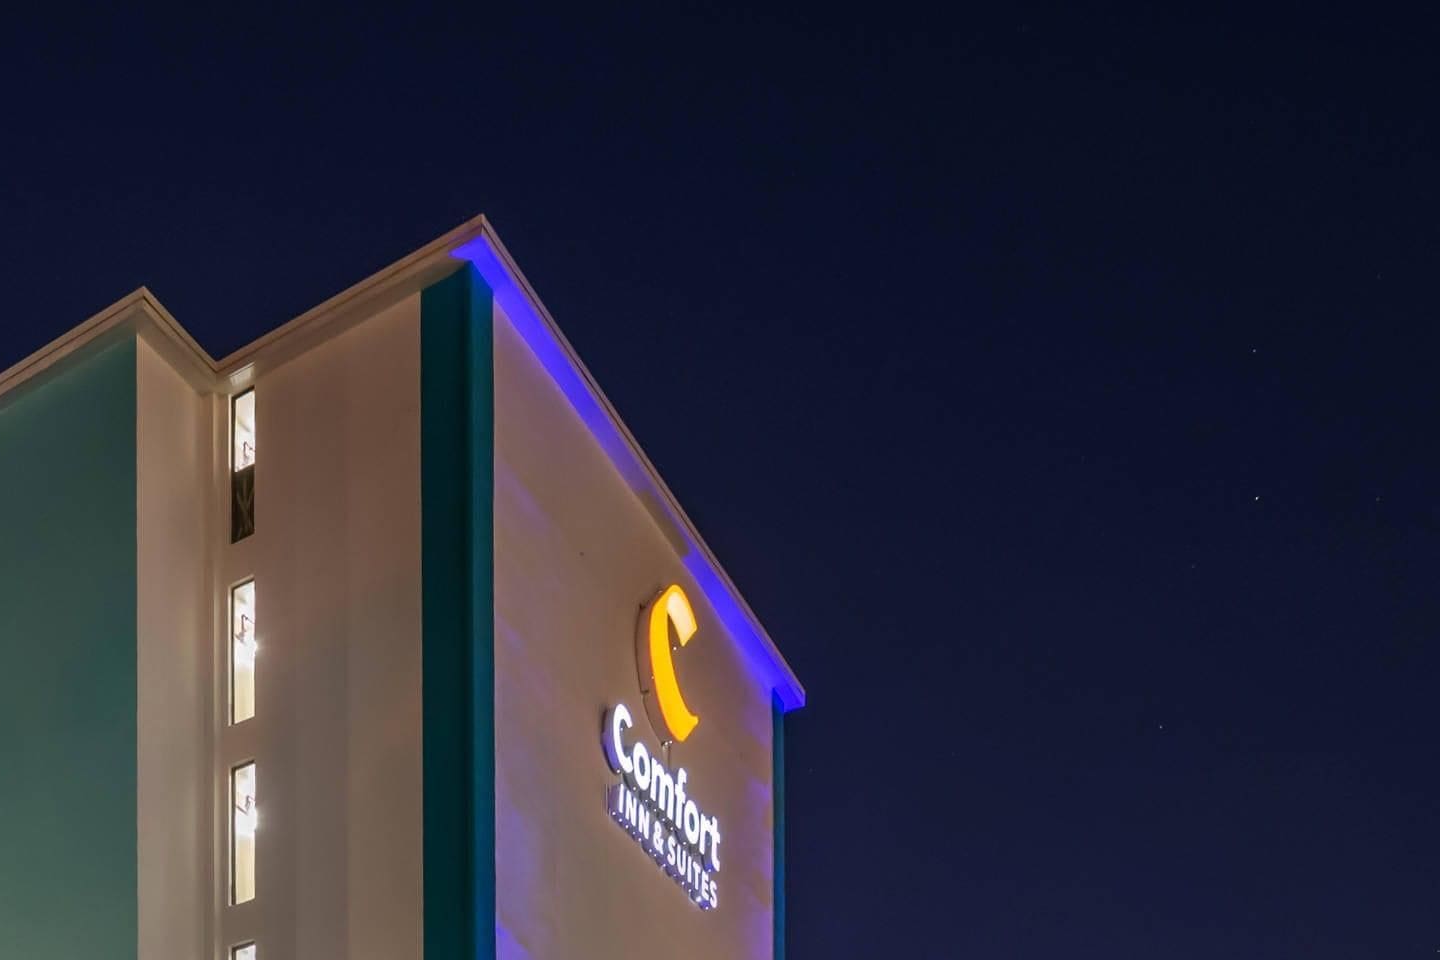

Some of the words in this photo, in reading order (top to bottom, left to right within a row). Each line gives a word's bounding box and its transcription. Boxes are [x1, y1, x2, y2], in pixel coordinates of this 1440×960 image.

[613, 703, 721, 873] Comfort
[618, 783, 650, 840] INN
[653, 820, 664, 855] &
[667, 836, 718, 909] SUITES
